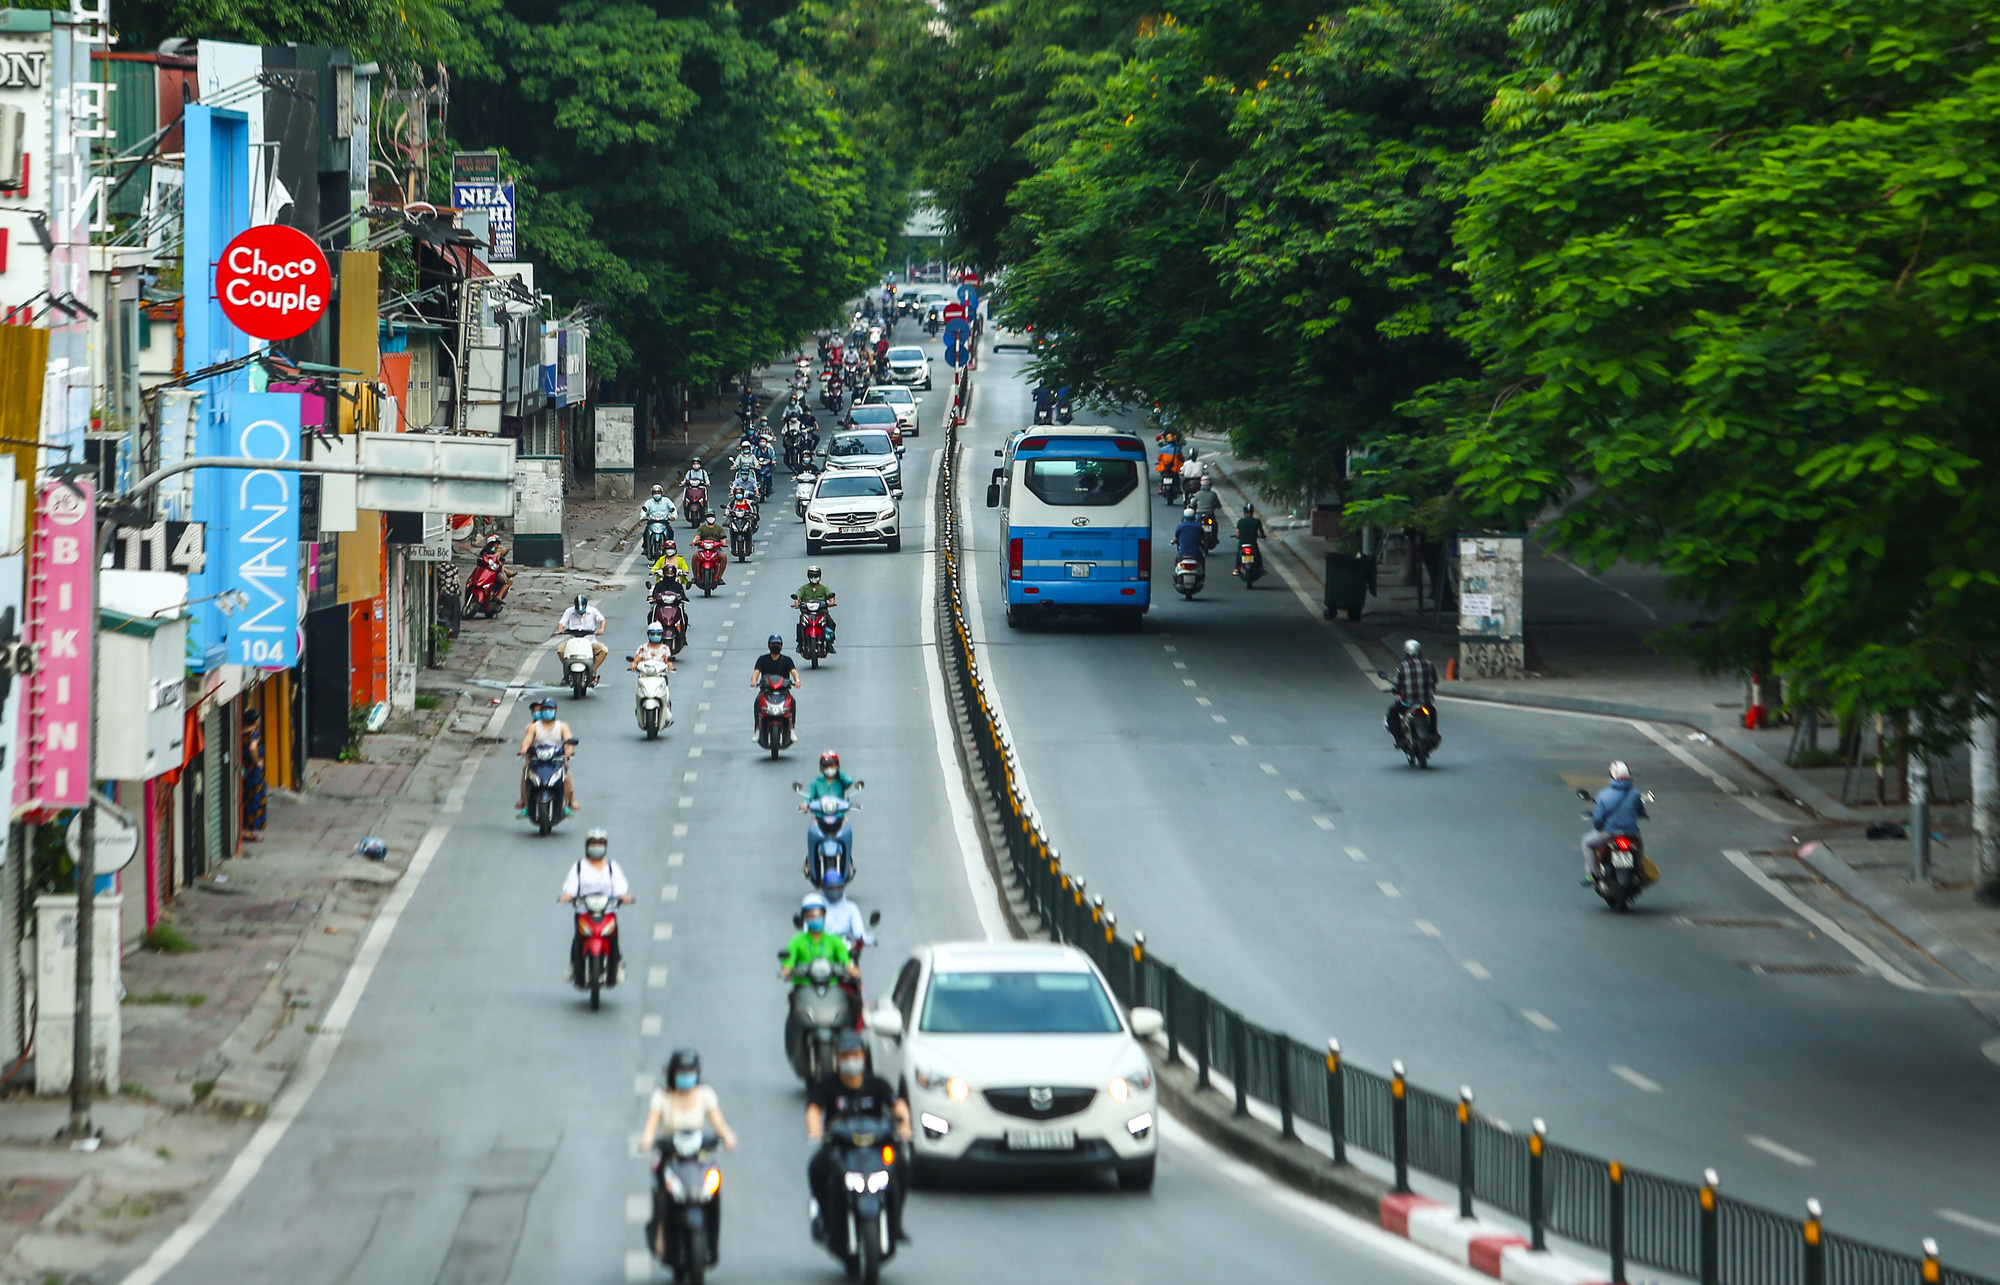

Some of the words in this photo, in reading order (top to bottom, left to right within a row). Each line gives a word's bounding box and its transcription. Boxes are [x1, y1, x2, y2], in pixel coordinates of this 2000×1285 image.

[228, 246, 317, 282] Choco
[226, 278, 321, 315] Couple
[116, 521, 207, 574] 114
[238, 419, 291, 633] MANDO
[46, 536, 80, 798] BIKINI
[241, 639, 284, 662] 104
